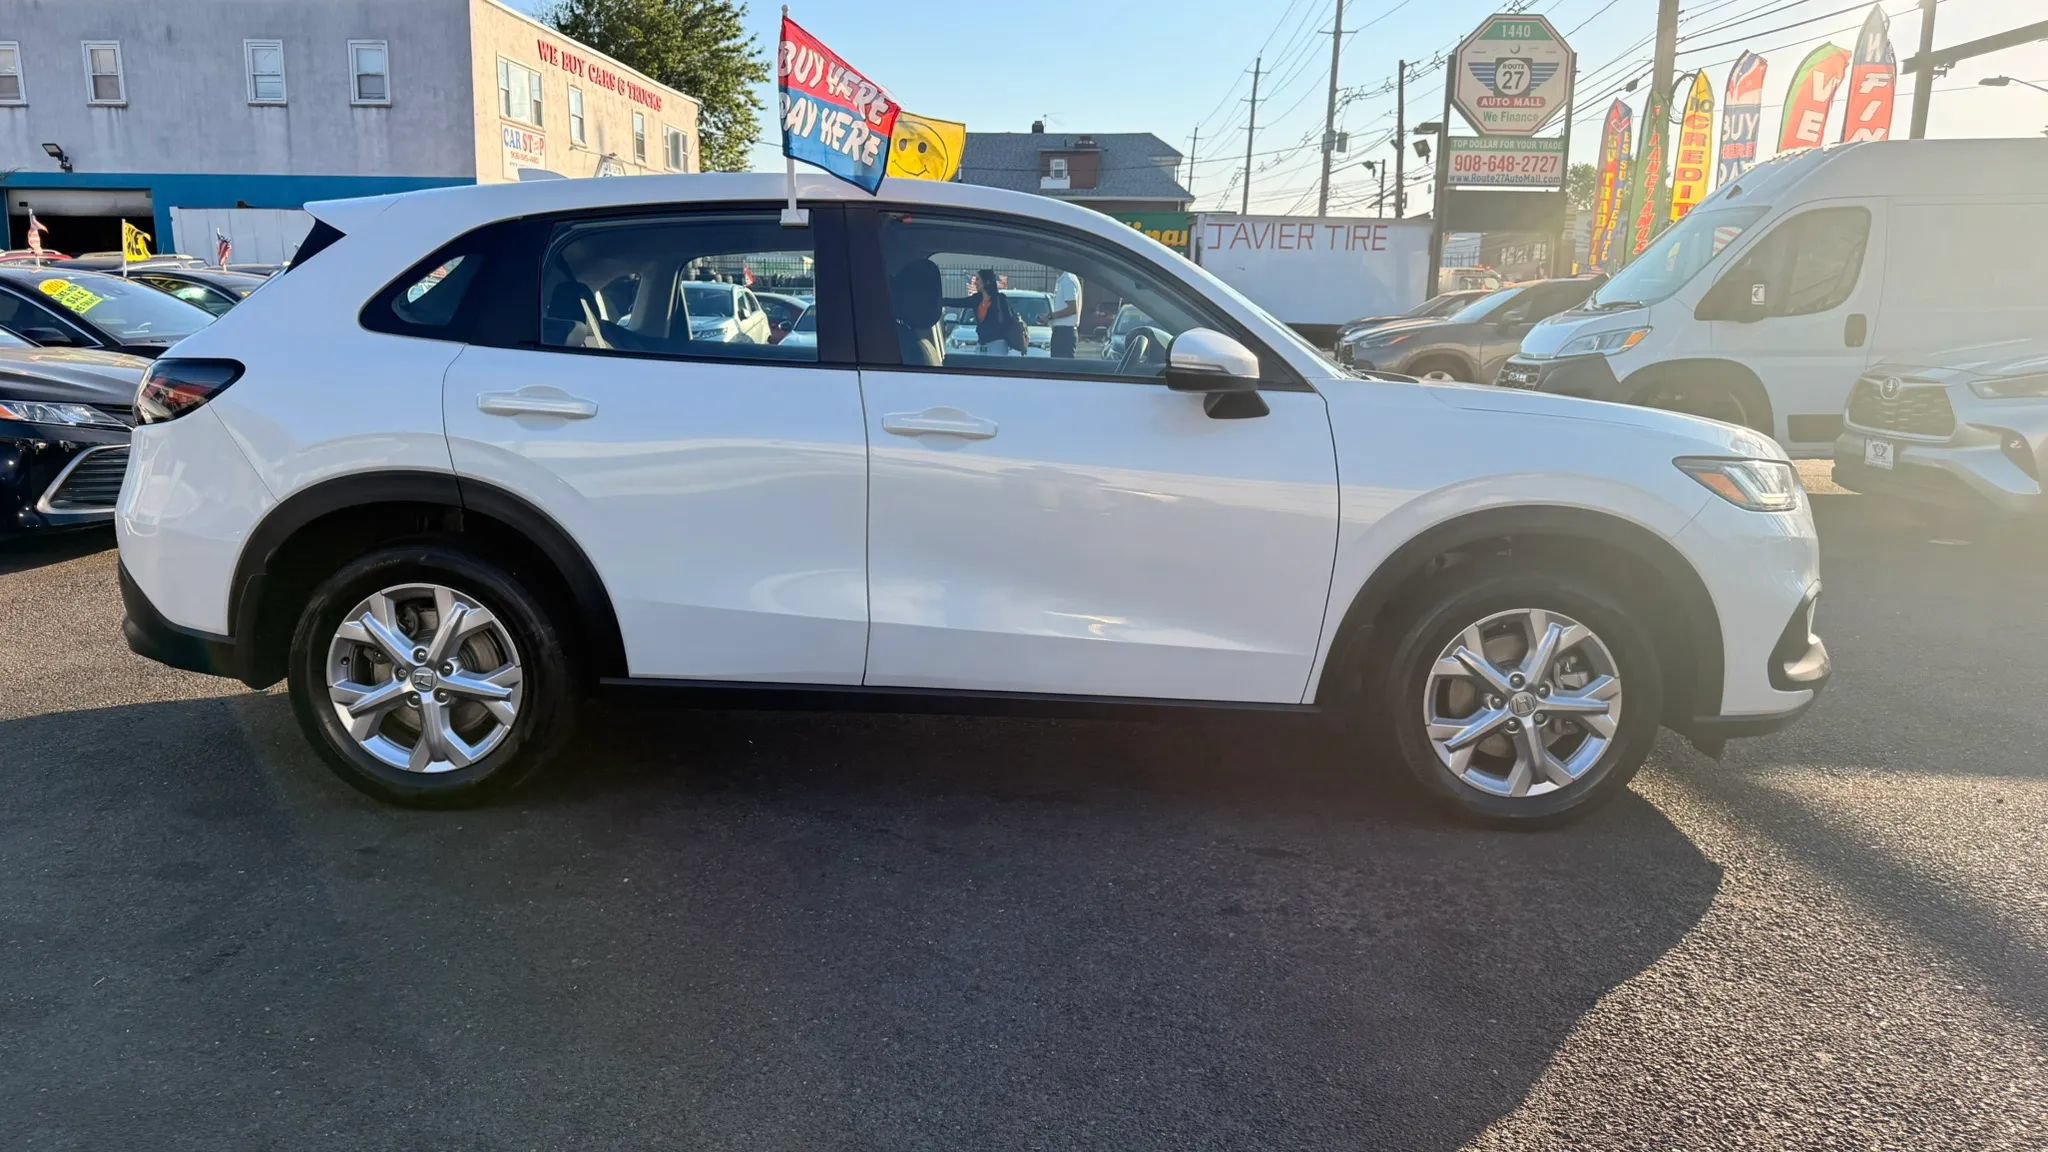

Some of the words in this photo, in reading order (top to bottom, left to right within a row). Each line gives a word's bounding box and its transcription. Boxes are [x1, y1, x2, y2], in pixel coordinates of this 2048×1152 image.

[1502, 25, 1531, 38] 1440
[537, 38, 558, 67] WE
[562, 51, 586, 78] BUY
[588, 63, 616, 90] CARS
[627, 81, 662, 112] TRUCKS
[778, 40, 826, 88] BUY
[826, 61, 889, 126] HERE
[1502, 70, 1525, 90] 27
[1480, 97, 1510, 107] AUTO
[1514, 97, 1542, 107] MALL
[1690, 96, 1714, 113] NO
[1483, 111, 1498, 122] We
[1500, 111, 1539, 122] Finance
[780, 92, 818, 138] PAY
[820, 107, 881, 167] HERE
[1722, 112, 1759, 142] BUY
[504, 127, 521, 150] CAR
[1454, 139, 1468, 148] TOP
[1469, 139, 1498, 149] DOLLAR
[1500, 140, 1513, 149] FOR
[1516, 140, 1537, 150] YOUR
[1539, 141, 1561, 150] TRADE
[1722, 143, 1754, 160] HERE
[1454, 154, 1558, 173] 908-648-2727
[1675, 114, 1711, 216] CREDIT
[1449, 173, 1560, 184] www.Route27AutoMall.com
[1718, 161, 1754, 187] PA
[1206, 222, 1314, 250] JAVIER
[1324, 224, 1389, 251] TIRE
